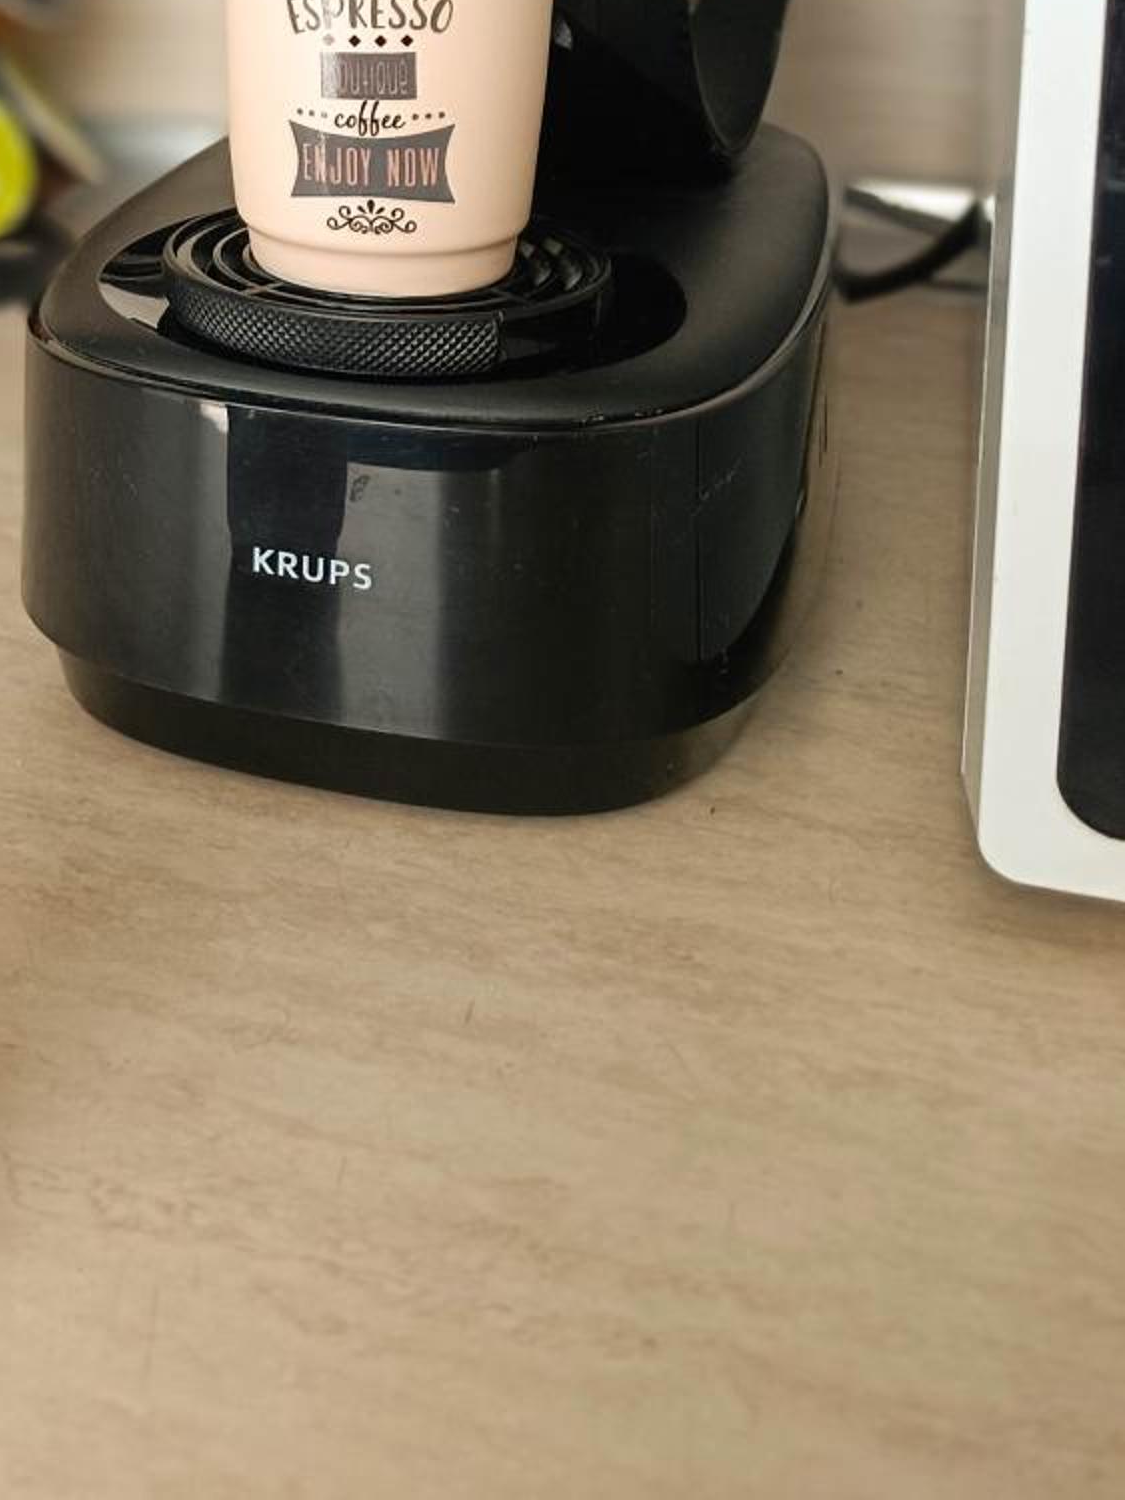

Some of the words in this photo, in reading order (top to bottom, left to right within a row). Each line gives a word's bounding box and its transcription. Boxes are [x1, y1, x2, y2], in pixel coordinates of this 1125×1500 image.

[334, 99, 406, 137] coffee
[302, 143, 372, 186] ENJOY
[387, 148, 439, 187] NOW
[252, 546, 373, 590] KRUPS
